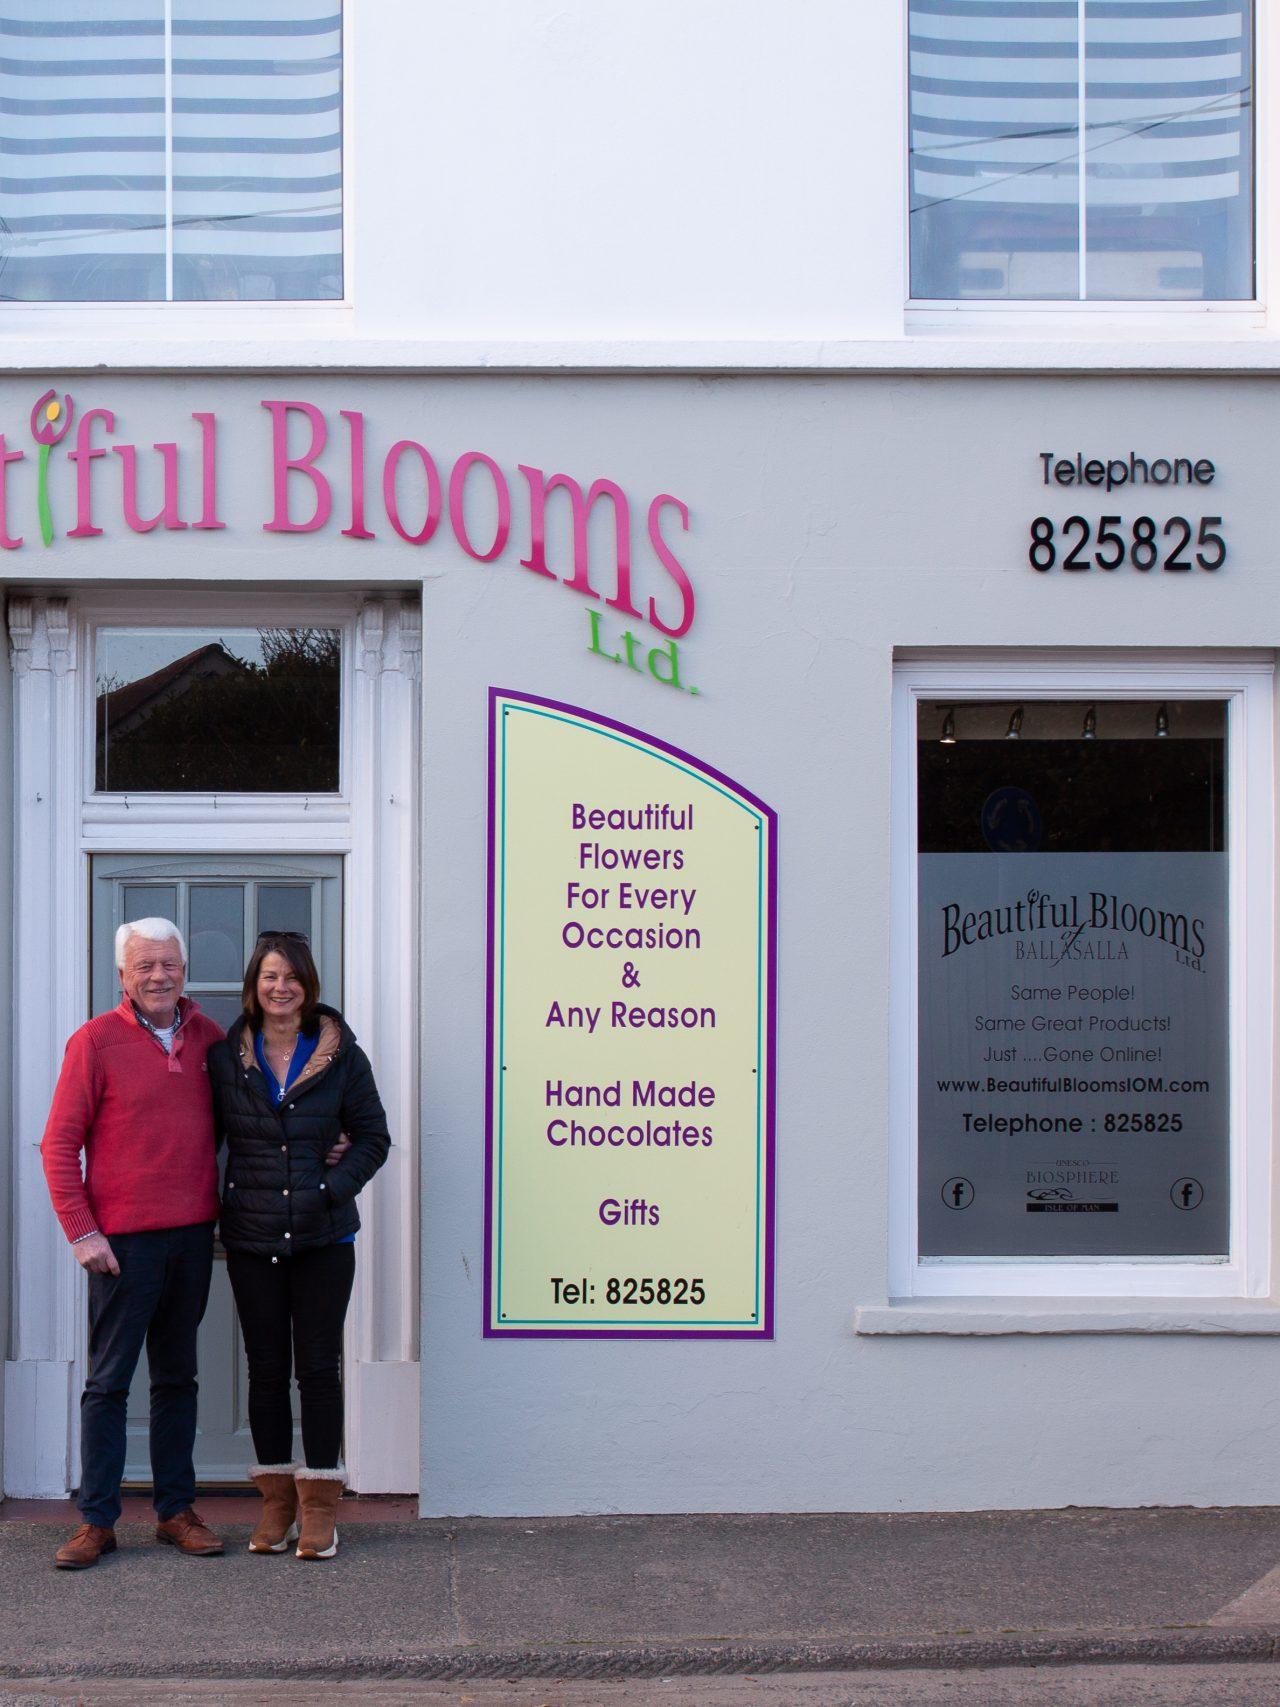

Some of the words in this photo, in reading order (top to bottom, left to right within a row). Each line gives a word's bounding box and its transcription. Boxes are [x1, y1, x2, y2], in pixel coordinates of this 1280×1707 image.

[1039, 452, 1216, 493] Telephone
[261, 399, 696, 637] Blooms
[1028, 515, 1227, 572] 825825
[572, 803, 693, 830] Beautiful
[580, 843, 684, 870] Flowers
[567, 882, 610, 909] For
[620, 882, 697, 915] Every
[562, 921, 701, 949] Occasion
[941, 888, 1081, 958] Beautiful
[1089, 892, 1206, 958] Blooms
[1015, 940, 1129, 960] BALLASALLA
[622, 961, 641, 988] &
[1011, 985, 1061, 1001] Same
[1068, 985, 1135, 1003] People!
[546, 1001, 601, 1033] Any
[611, 1001, 716, 1028] Reason
[975, 1016, 1025, 1031] Same
[1031, 1016, 1083, 1031] Great
[1089, 1016, 1171, 1031] Products!
[983, 1047, 1017, 1062] Just
[1100, 1047, 1162, 1062] Online!
[546, 1080, 621, 1107] Hand
[632, 1080, 716, 1107] Made
[936, 1077, 1210, 1093] www.BeautifulBloomsIOM.com
[547, 1119, 713, 1146] Chocolates
[962, 1113, 1083, 1136] Telephone
[1103, 1113, 1183, 1133] 825825
[1026, 1170, 1119, 1185] BIOSPHERE
[599, 1198, 660, 1225] Gifts
[551, 1277, 595, 1304] Tel:
[606, 1277, 706, 1304] 825825
